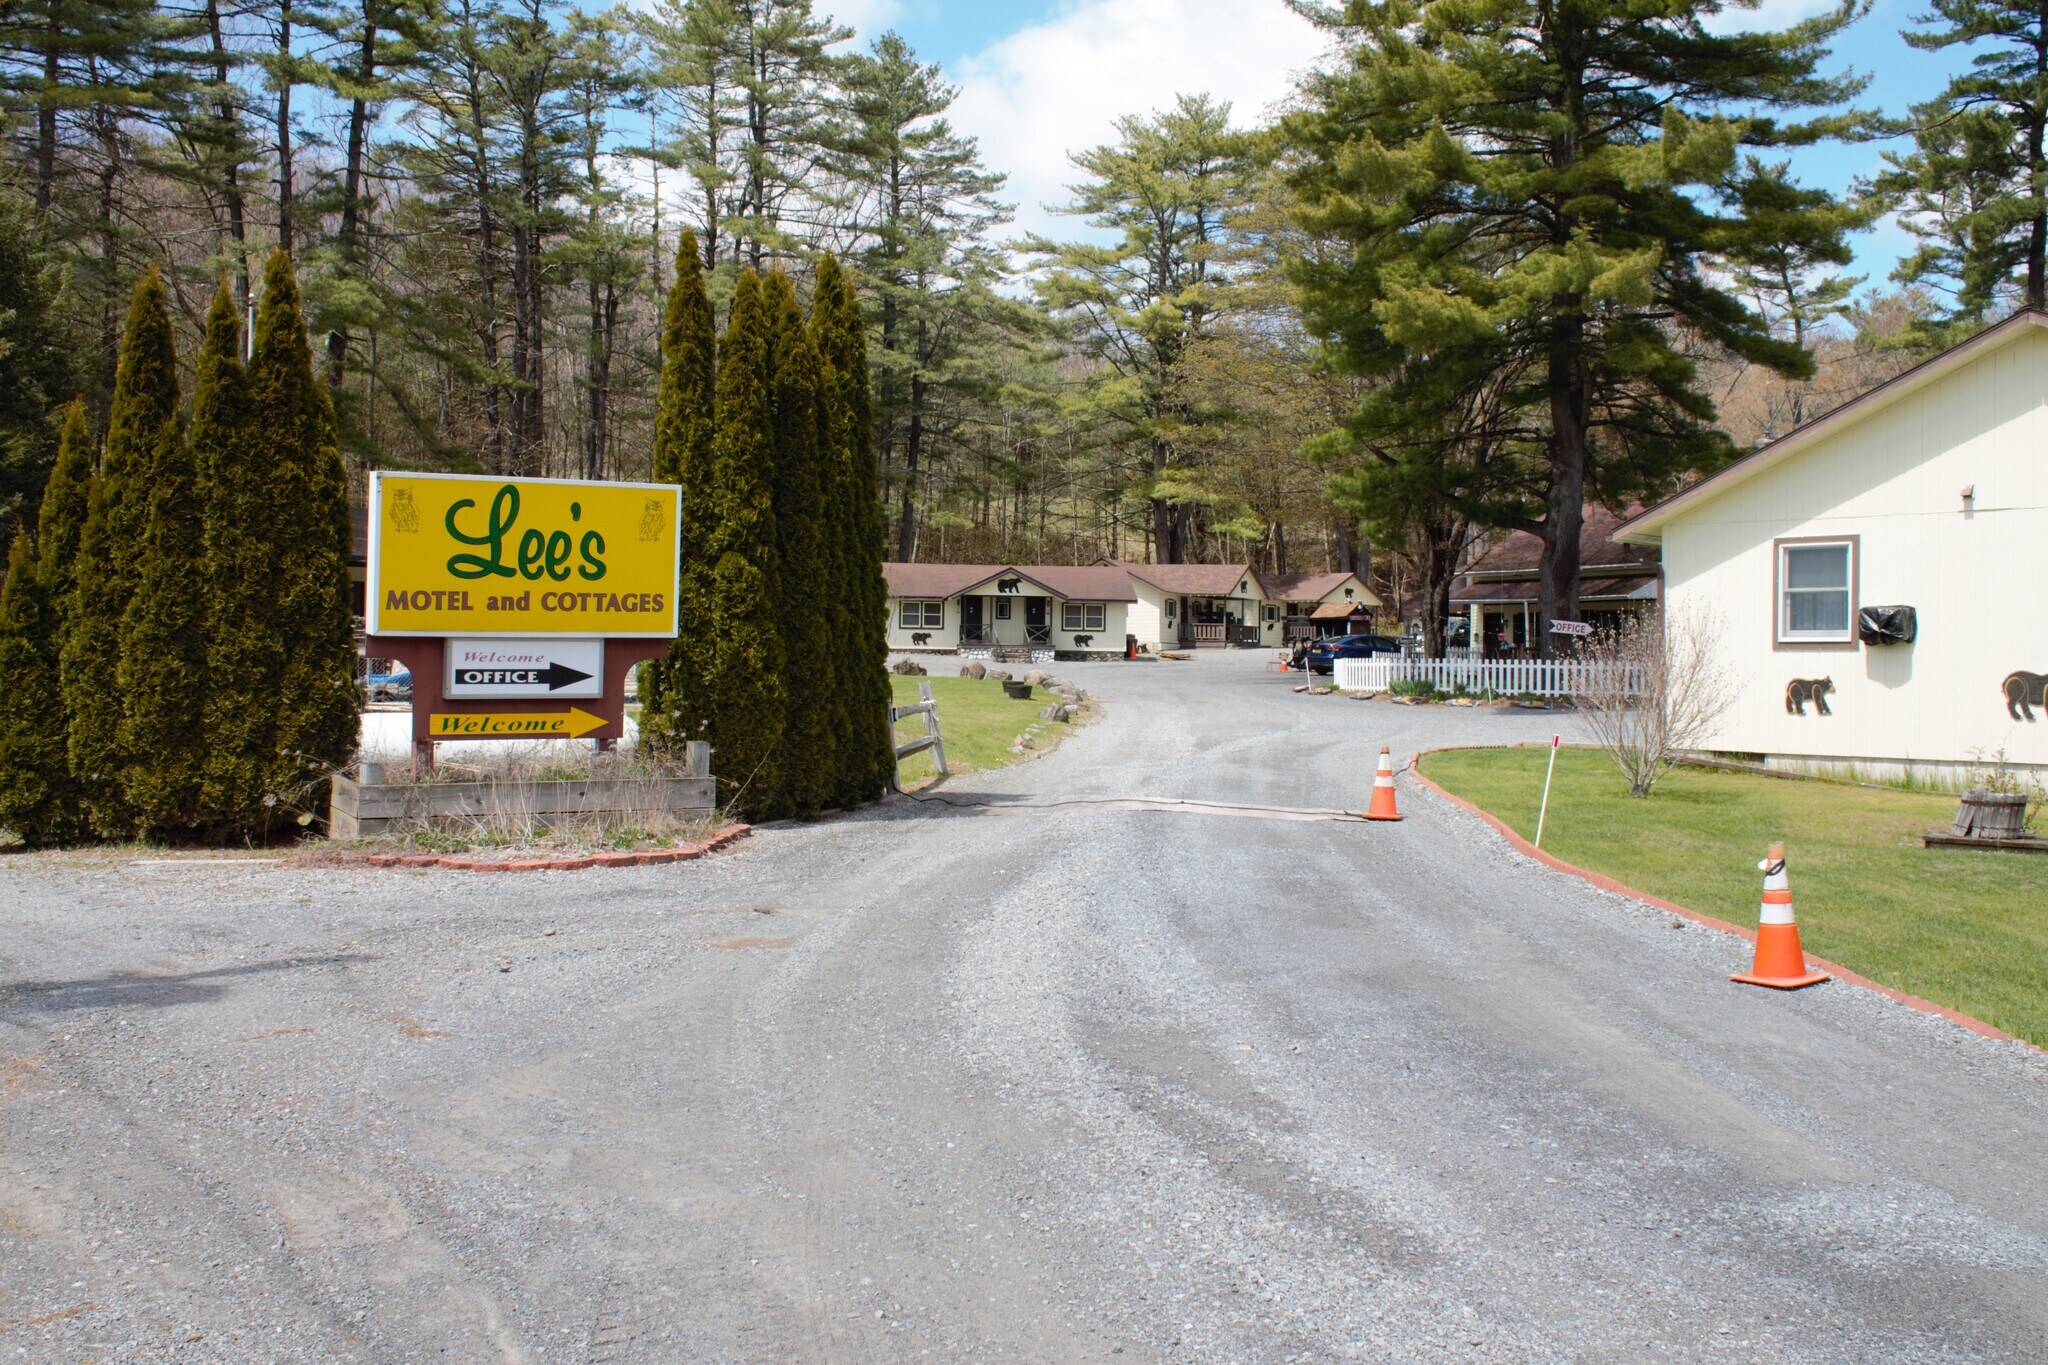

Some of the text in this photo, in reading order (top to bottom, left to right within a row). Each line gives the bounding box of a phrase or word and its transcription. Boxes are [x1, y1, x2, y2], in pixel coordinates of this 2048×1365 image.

[446, 484, 607, 581] Lee's
[386, 590, 664, 612] MOTEL and COTTAGES
[1556, 623, 1586, 633] OFFICE
[464, 651, 544, 663] Welcome
[464, 671, 538, 683] OFFICE
[442, 717, 564, 732] Welcome
